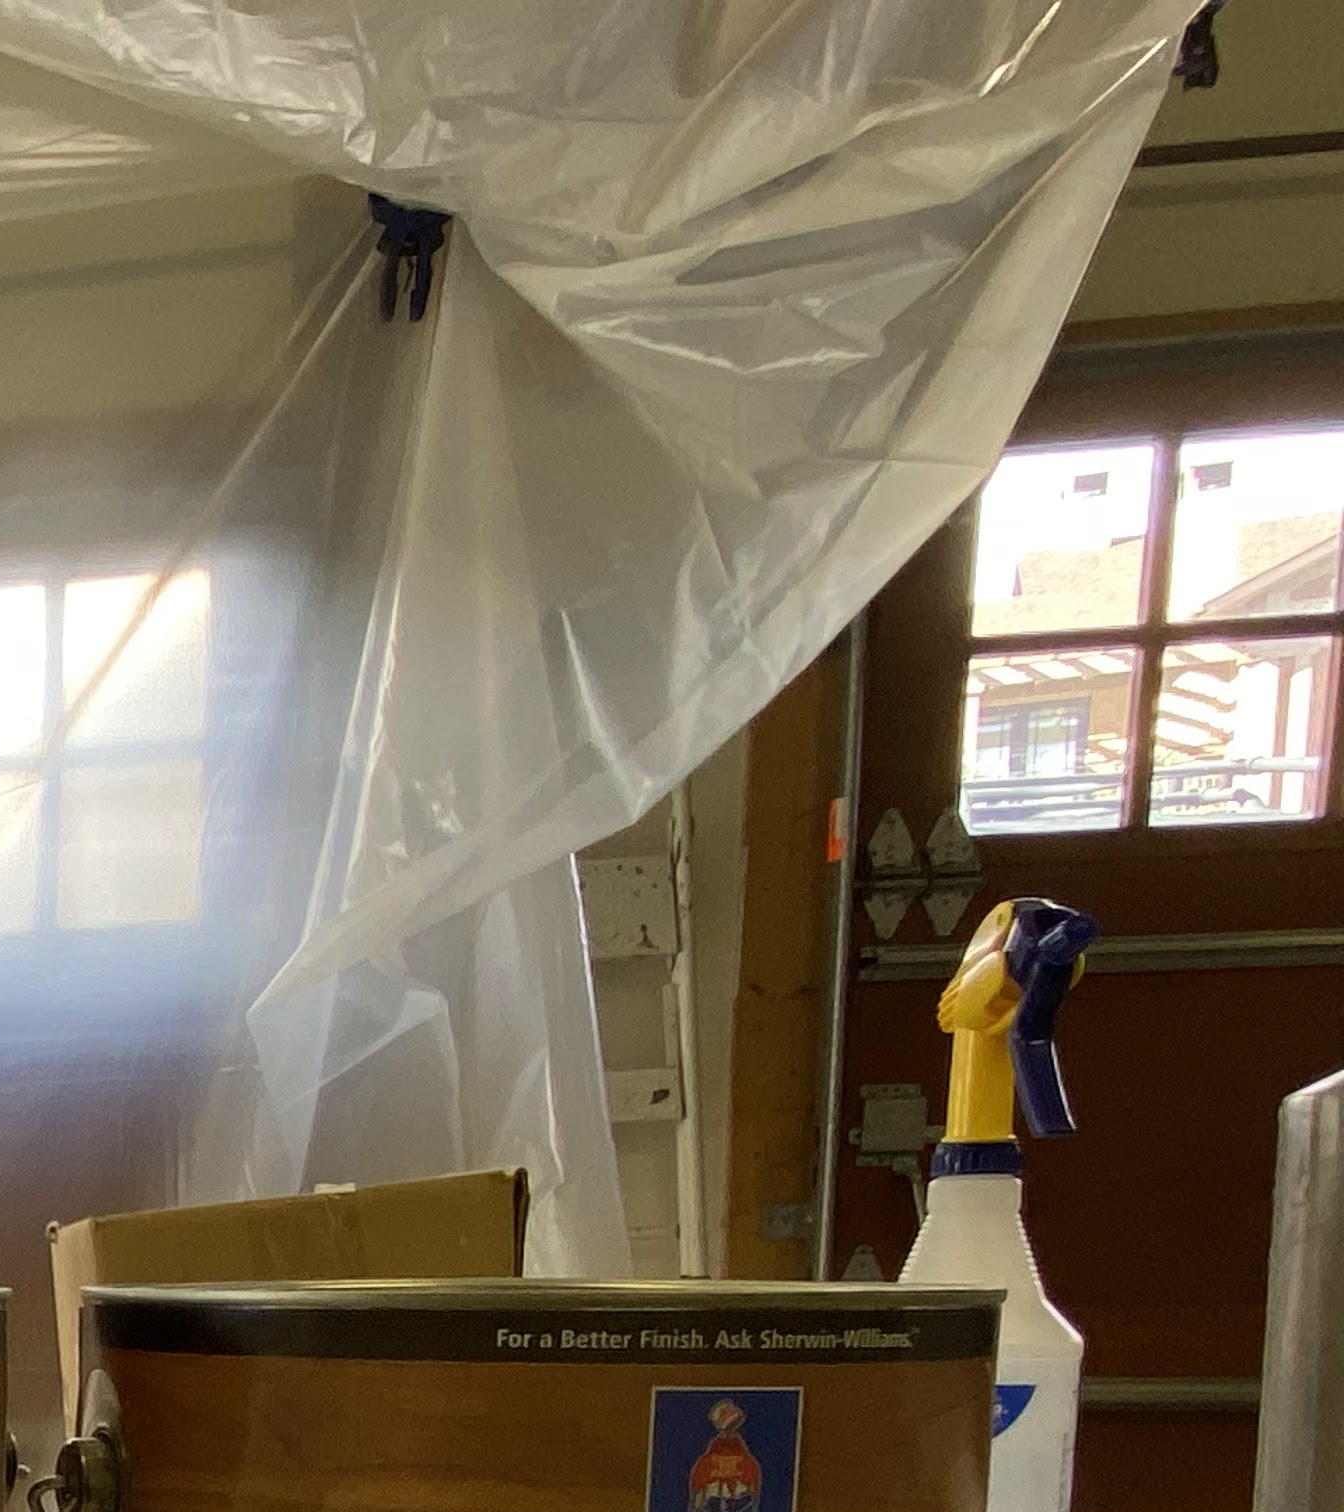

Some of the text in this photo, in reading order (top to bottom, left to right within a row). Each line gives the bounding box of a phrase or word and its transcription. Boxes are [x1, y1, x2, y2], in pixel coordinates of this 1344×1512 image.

[496, 1328, 752, 1349] For Better Ask
